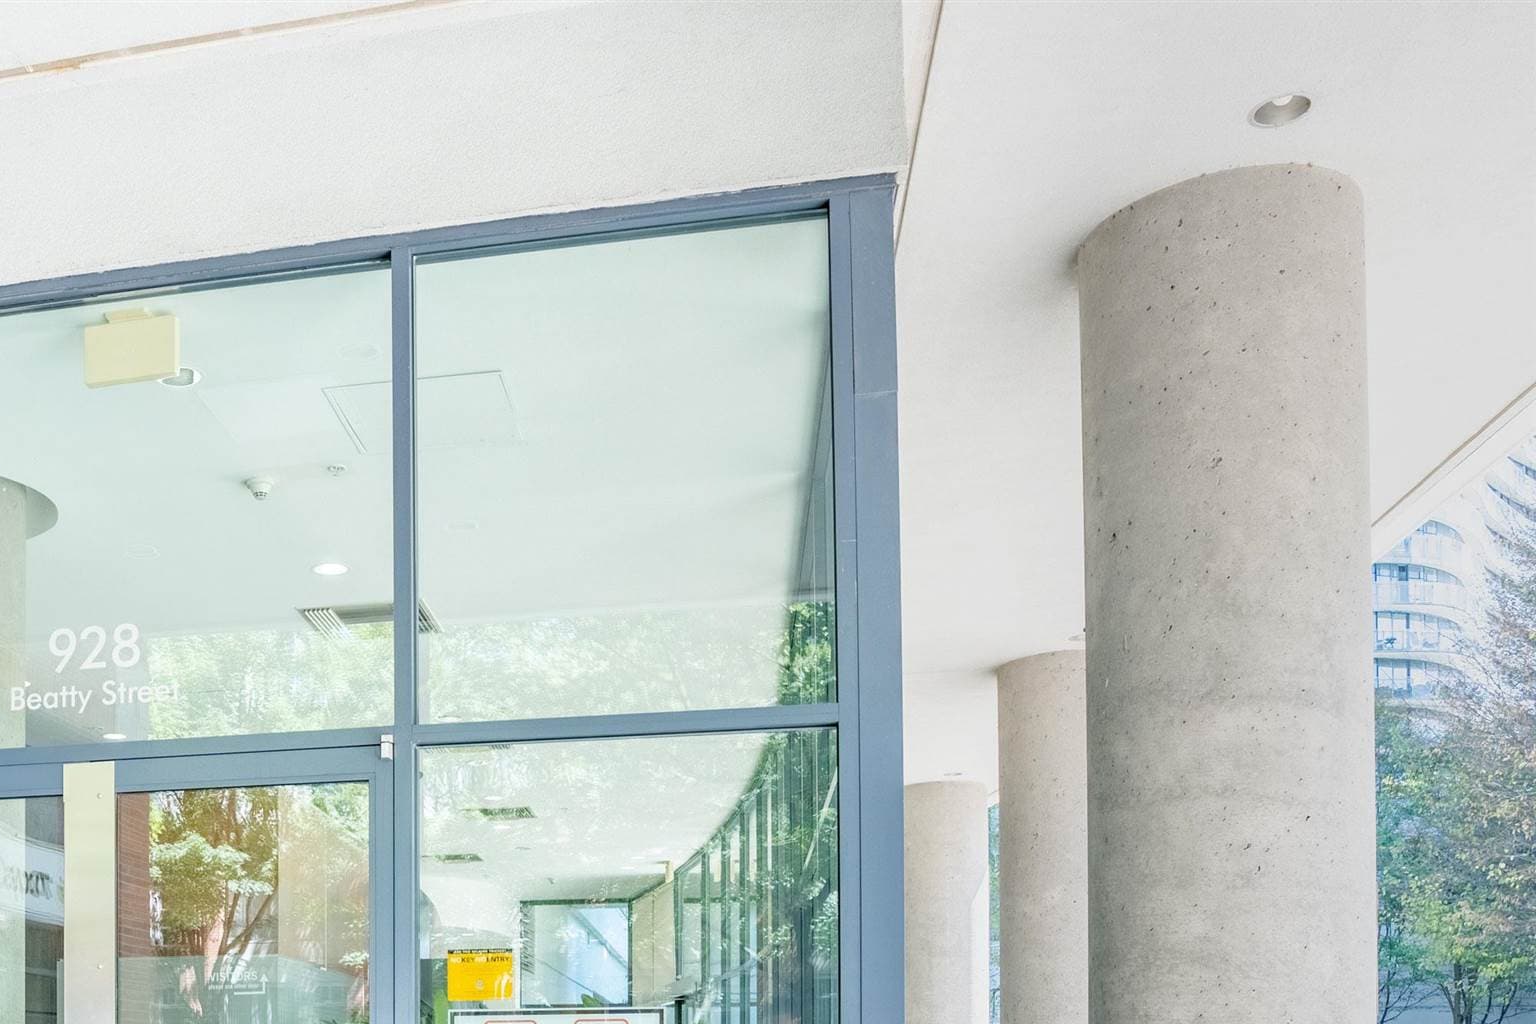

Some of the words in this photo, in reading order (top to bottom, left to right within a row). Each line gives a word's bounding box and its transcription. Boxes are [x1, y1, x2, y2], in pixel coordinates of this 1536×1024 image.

[48, 623, 141, 674] 928
[10, 685, 93, 714] Beatty
[101, 680, 180, 705] Street
[209, 971, 258, 982] VISIORS
